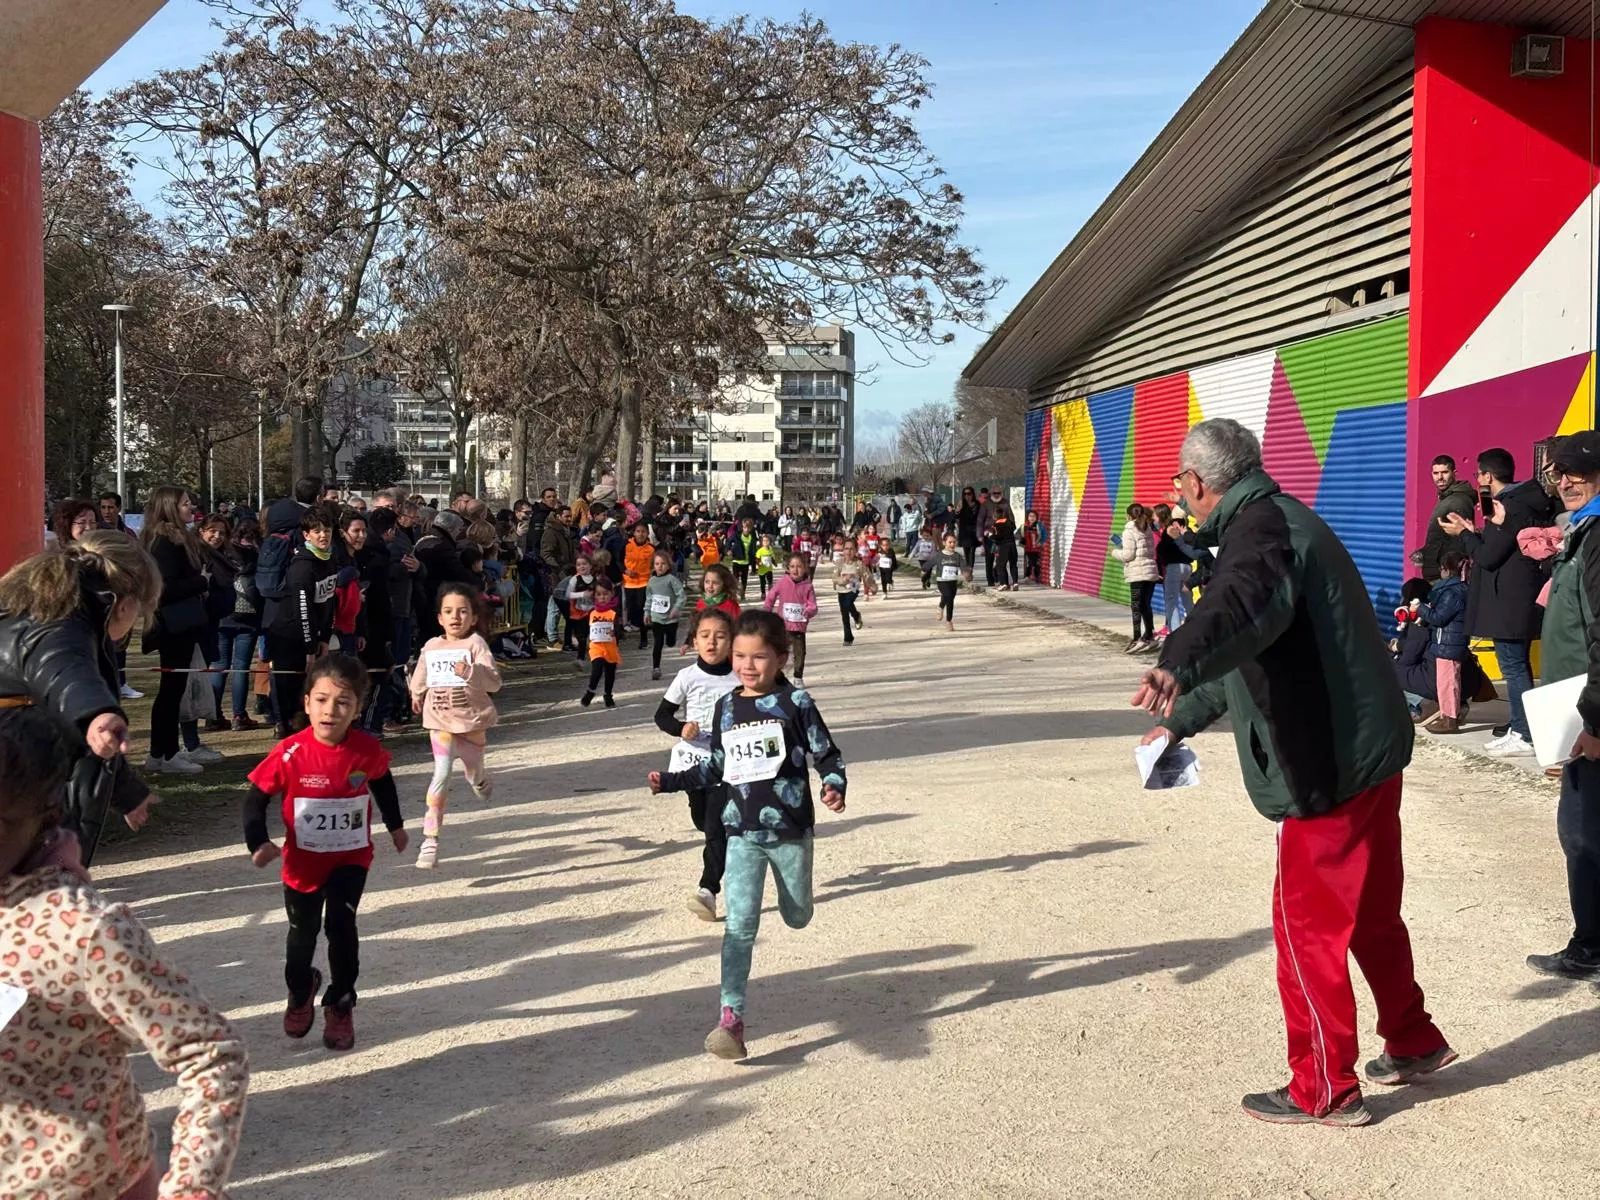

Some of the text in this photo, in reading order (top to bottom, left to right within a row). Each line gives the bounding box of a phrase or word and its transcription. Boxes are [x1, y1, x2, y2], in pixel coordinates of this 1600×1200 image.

[435, 660, 456, 673] 378
[735, 740, 764, 761] 345
[316, 813, 350, 831] 213
